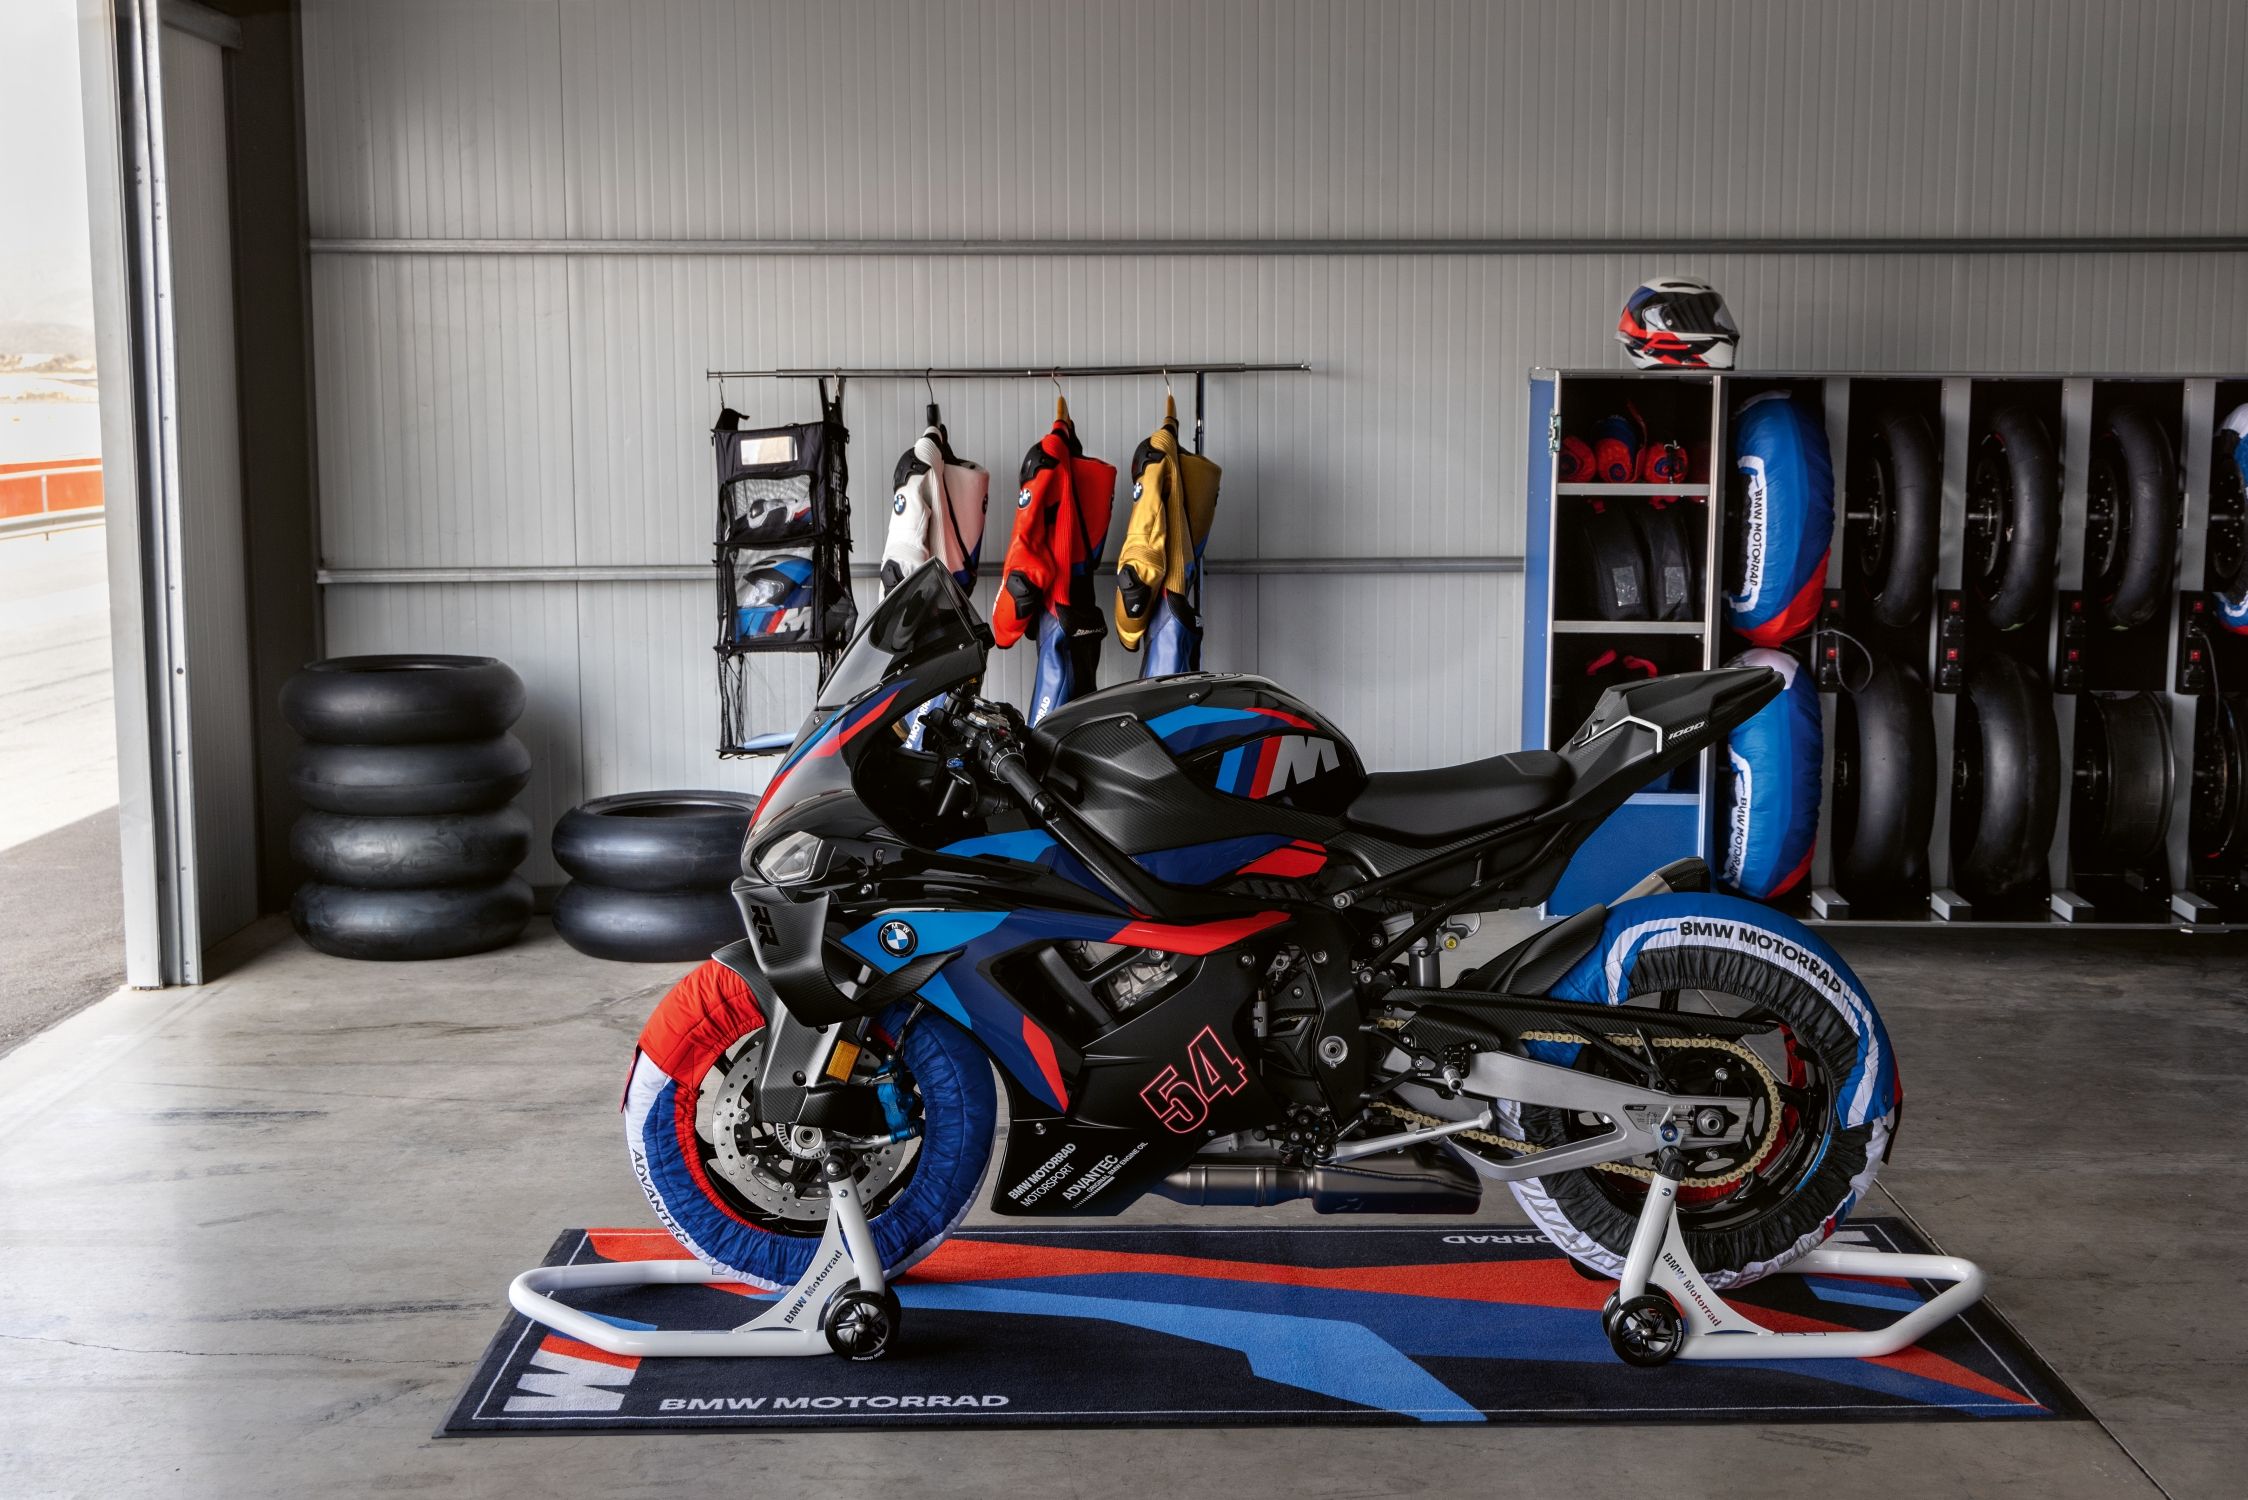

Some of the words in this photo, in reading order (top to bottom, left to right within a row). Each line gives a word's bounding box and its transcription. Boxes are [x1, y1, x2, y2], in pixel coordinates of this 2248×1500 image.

[1753, 488, 1764, 520] BMW
[1668, 721, 1705, 740] 1000
[1266, 734, 1341, 797] M
[751, 905, 780, 949] RR
[1679, 921, 1734, 939] BMW
[1739, 927, 1842, 993] MOTORRAD
[1139, 1024, 1248, 1134] 54
[1008, 1179, 1033, 1200] BMW
[1027, 1143, 1076, 1184] MOTORRAD
[1119, 1148, 1140, 1165] ENGINE
[1136, 1141, 1149, 1150] OIL
[632, 1148, 689, 1245] ADVANTEC
[1020, 1162, 1075, 1207] MOTORSPORT
[1062, 1154, 1119, 1201] ADVANTEC
[1442, 1235, 1556, 1244] ORRAD
[783, 1296, 808, 1324] BMW
[804, 1249, 843, 1297] Motorrad
[1662, 1252, 1687, 1280] BMW
[1683, 1279, 1722, 1327] Motorrad
[658, 1397, 767, 1411] BMW
[772, 1395, 1010, 1410] MOTORRAD
